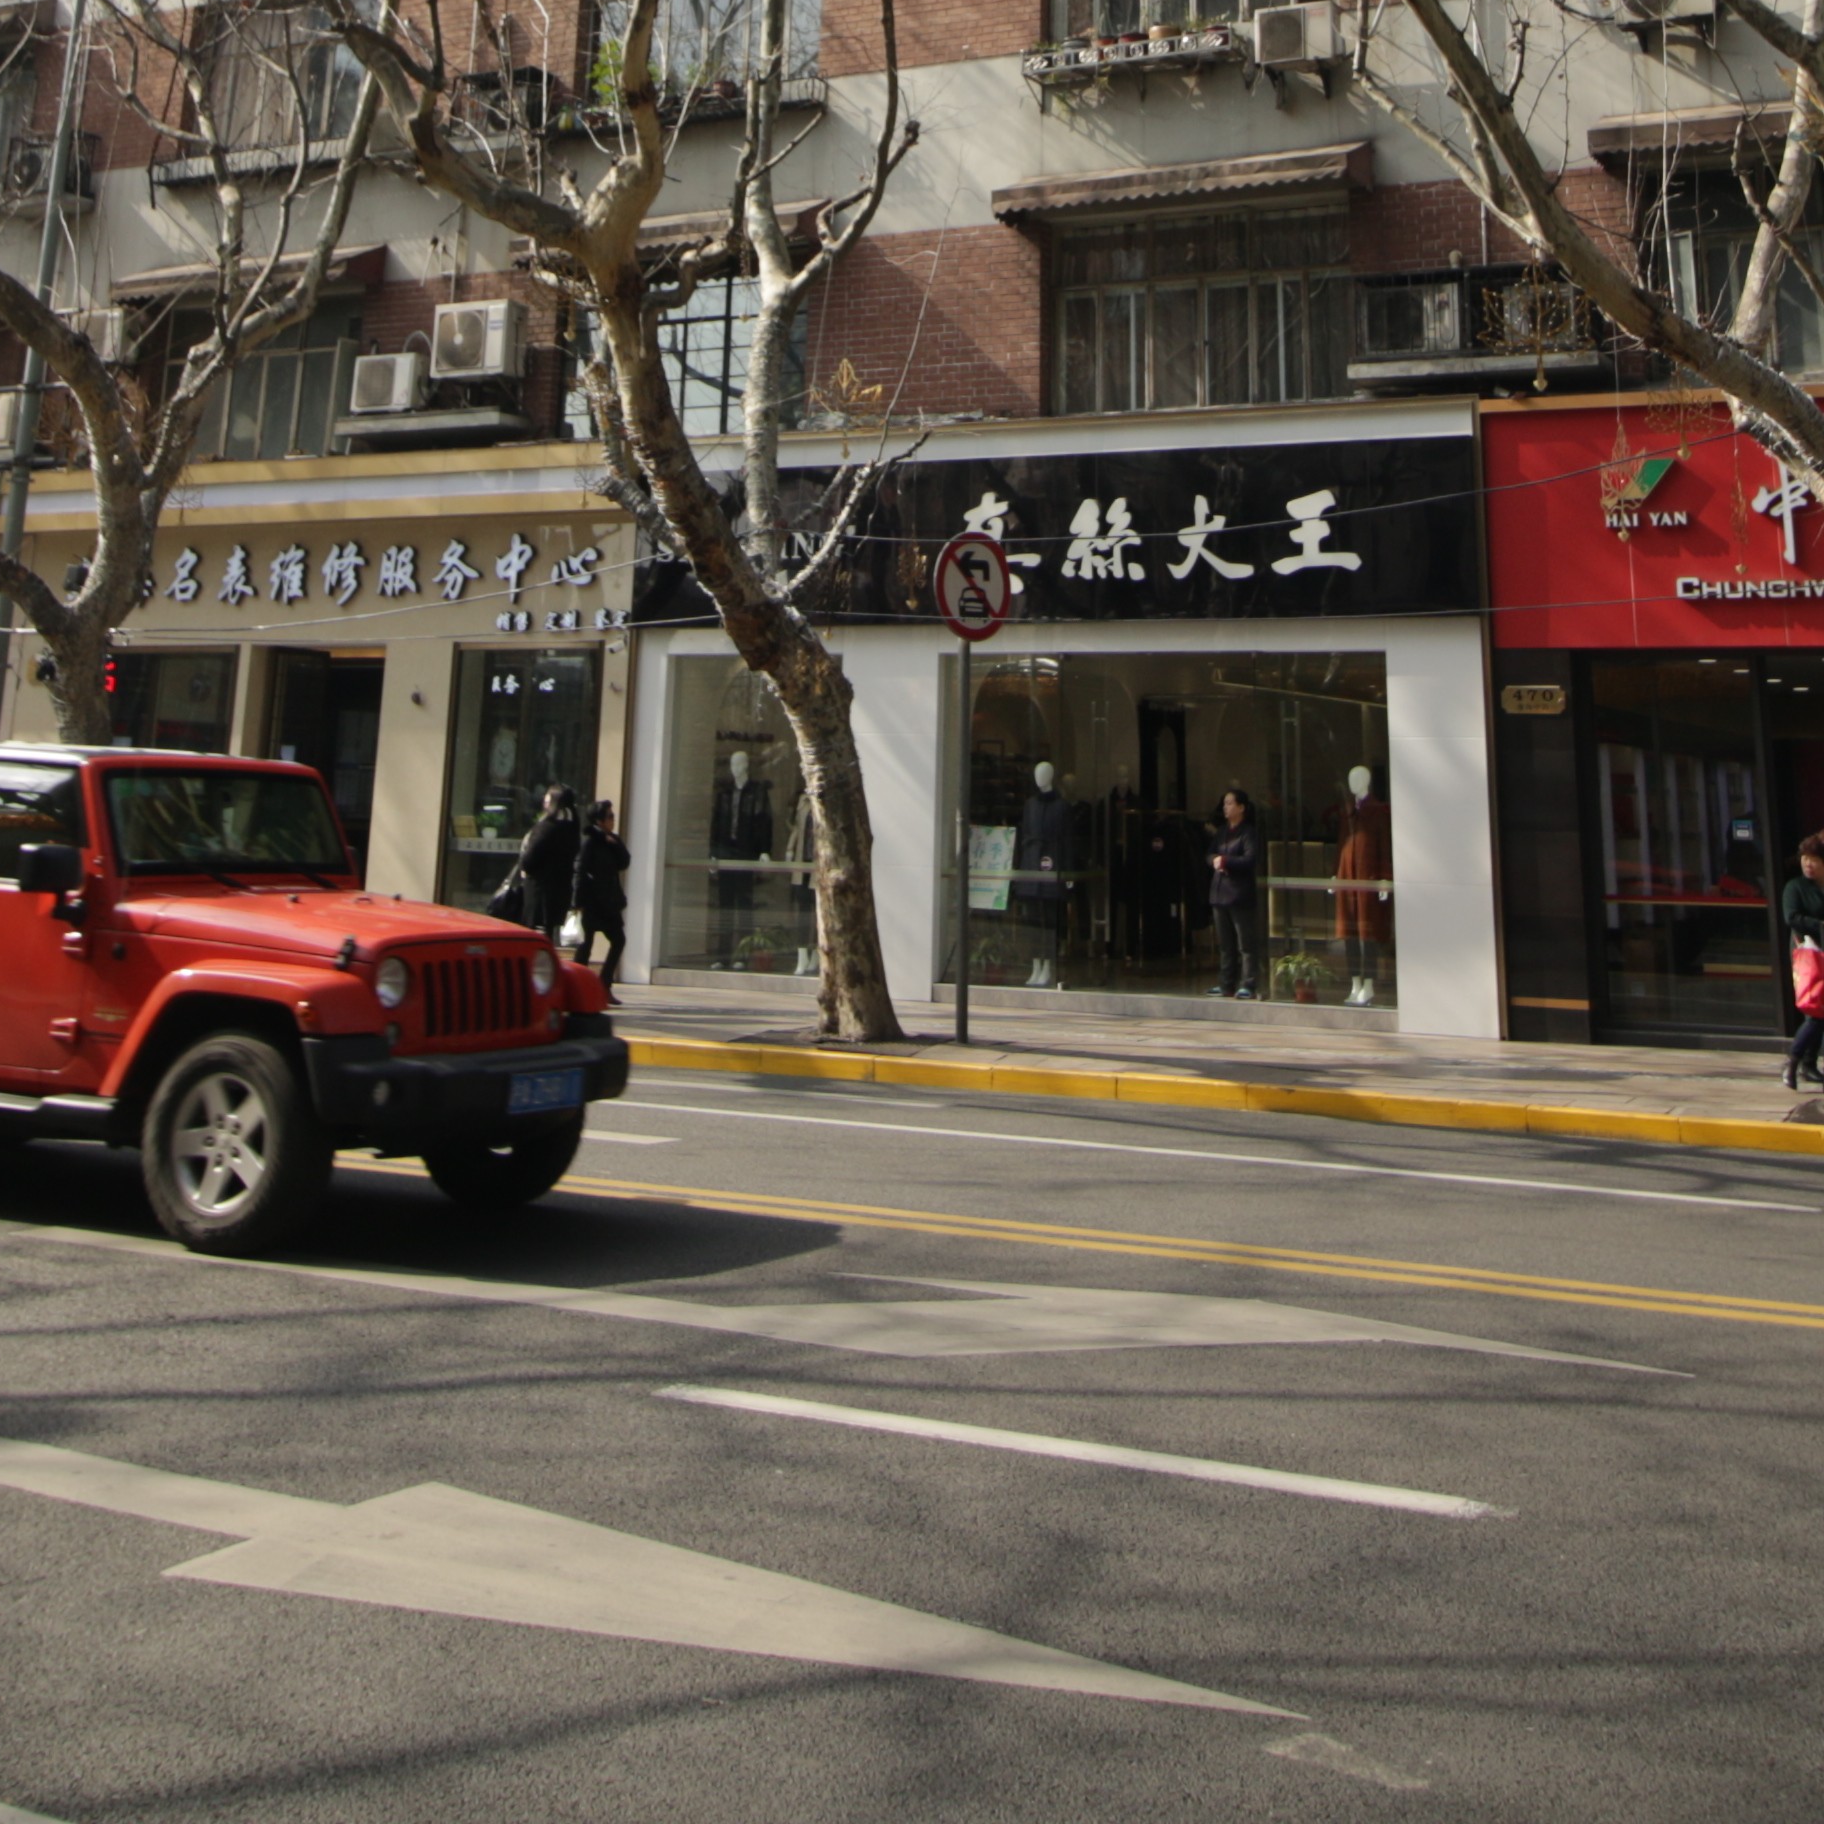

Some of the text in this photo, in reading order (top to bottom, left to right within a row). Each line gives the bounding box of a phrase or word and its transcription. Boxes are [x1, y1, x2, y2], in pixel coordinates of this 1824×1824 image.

[1605, 511, 1688, 528] HAI YAN
[144, 533, 604, 606] 名表维修服务中心
[1512, 689, 1555, 702] 470
